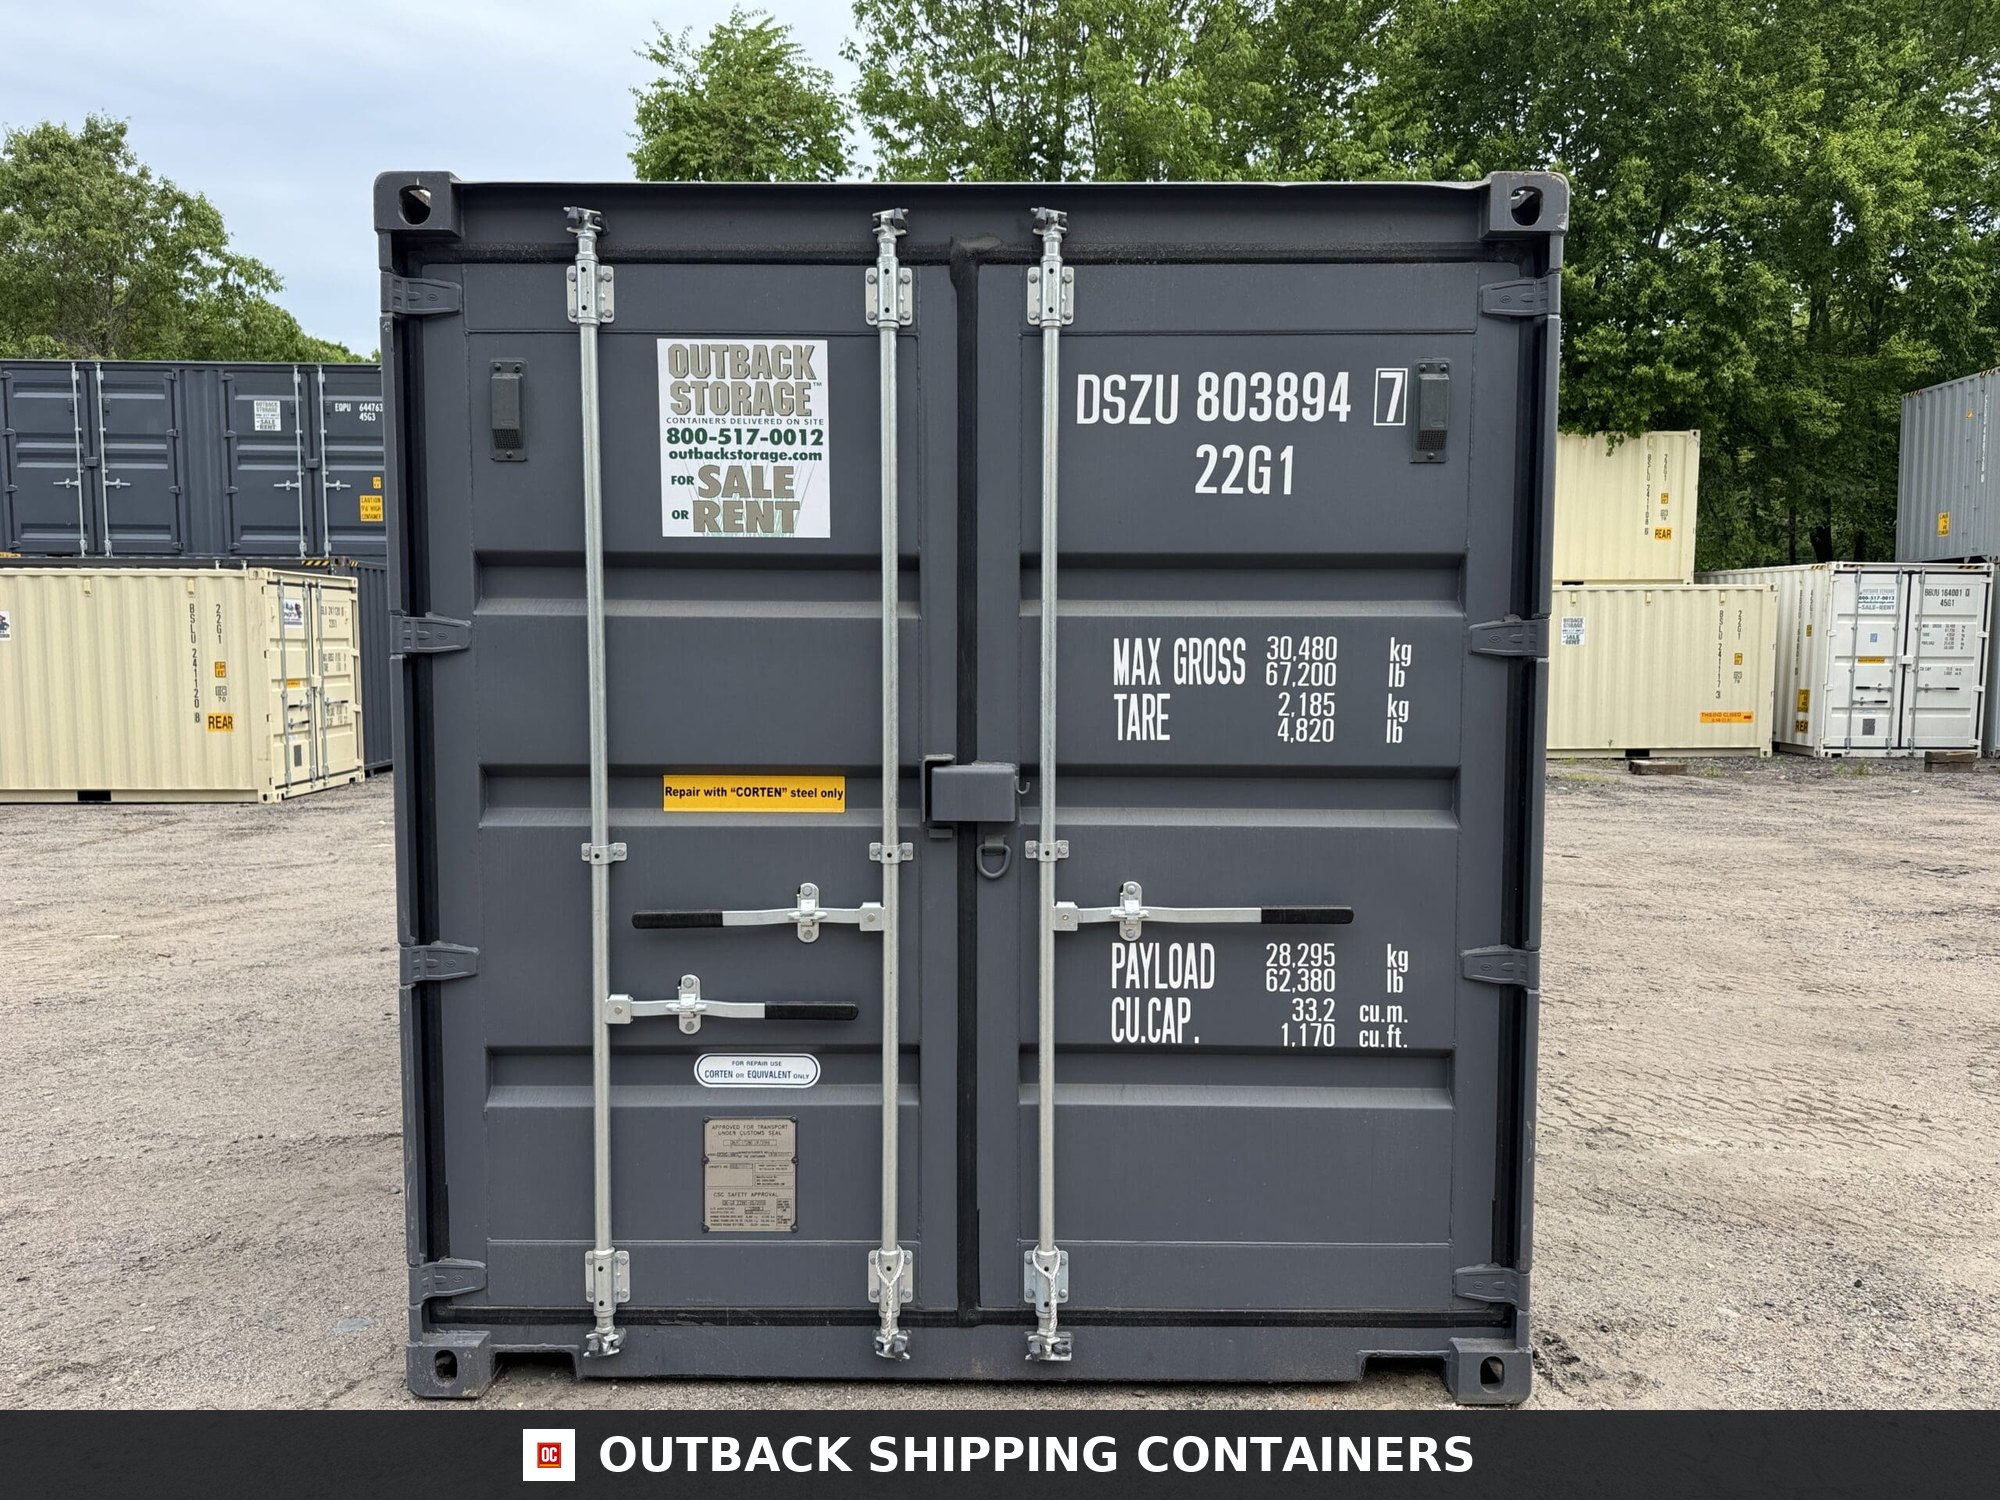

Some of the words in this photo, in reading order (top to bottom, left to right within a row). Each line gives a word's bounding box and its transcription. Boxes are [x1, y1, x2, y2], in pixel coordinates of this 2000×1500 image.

[668, 343, 817, 380] OUTBACK
[669, 380, 813, 416] STORAGE
[1077, 374, 1179, 425] DSZU
[1196, 371, 1351, 423] 803894
[1381, 371, 1403, 422] 7
[666, 417, 727, 425] CONTAINERS
[730, 417, 783, 425] DELIVERED
[666, 427, 824, 446] 800-517-0012
[669, 447, 823, 463] outbackstorage.com
[1195, 444, 1294, 495] 22G1
[671, 475, 694, 485] FOR
[697, 464, 795, 499] SALE
[671, 509, 689, 520] OR
[692, 500, 801, 534] RENT
[192, 648, 200, 708] 241120
[1113, 638, 1161, 686] MAX
[1173, 637, 1246, 686] GROSS
[1266, 636, 1338, 663] 30,480
[1389, 637, 1412, 667] kg
[1265, 662, 1337, 688] 67,200
[1388, 665, 1405, 688] lb
[208, 716, 233, 730] REAR
[1113, 693, 1171, 741] TARE
[1278, 692, 1335, 718] 2,185
[1387, 693, 1410, 723] kg
[1277, 718, 1335, 744] 4,820
[1386, 718, 1403, 744] lb
[665, 787, 700, 799] Repair
[703, 787, 727, 797] with
[730, 787, 788, 798] “CORTEN”
[790, 788, 817, 798] steel
[820, 788, 844, 800] only
[1111, 943, 1215, 990] PAYLOAD
[1266, 943, 1336, 969] 28,295
[1387, 944, 1409, 973] kg
[1265, 968, 1336, 994] 62,380
[1387, 968, 1404, 994] lb
[1111, 996, 1200, 1044] CU.CAP.
[1287, 998, 1336, 1023] 33.2
[1359, 1002, 1408, 1024] cu.m.
[1281, 1023, 1336, 1048] 1,170
[1359, 1024, 1408, 1048] cu.ft.
[704, 1070, 733, 1079] CORTEN
[747, 1070, 791, 1079] EQUIVALENT
